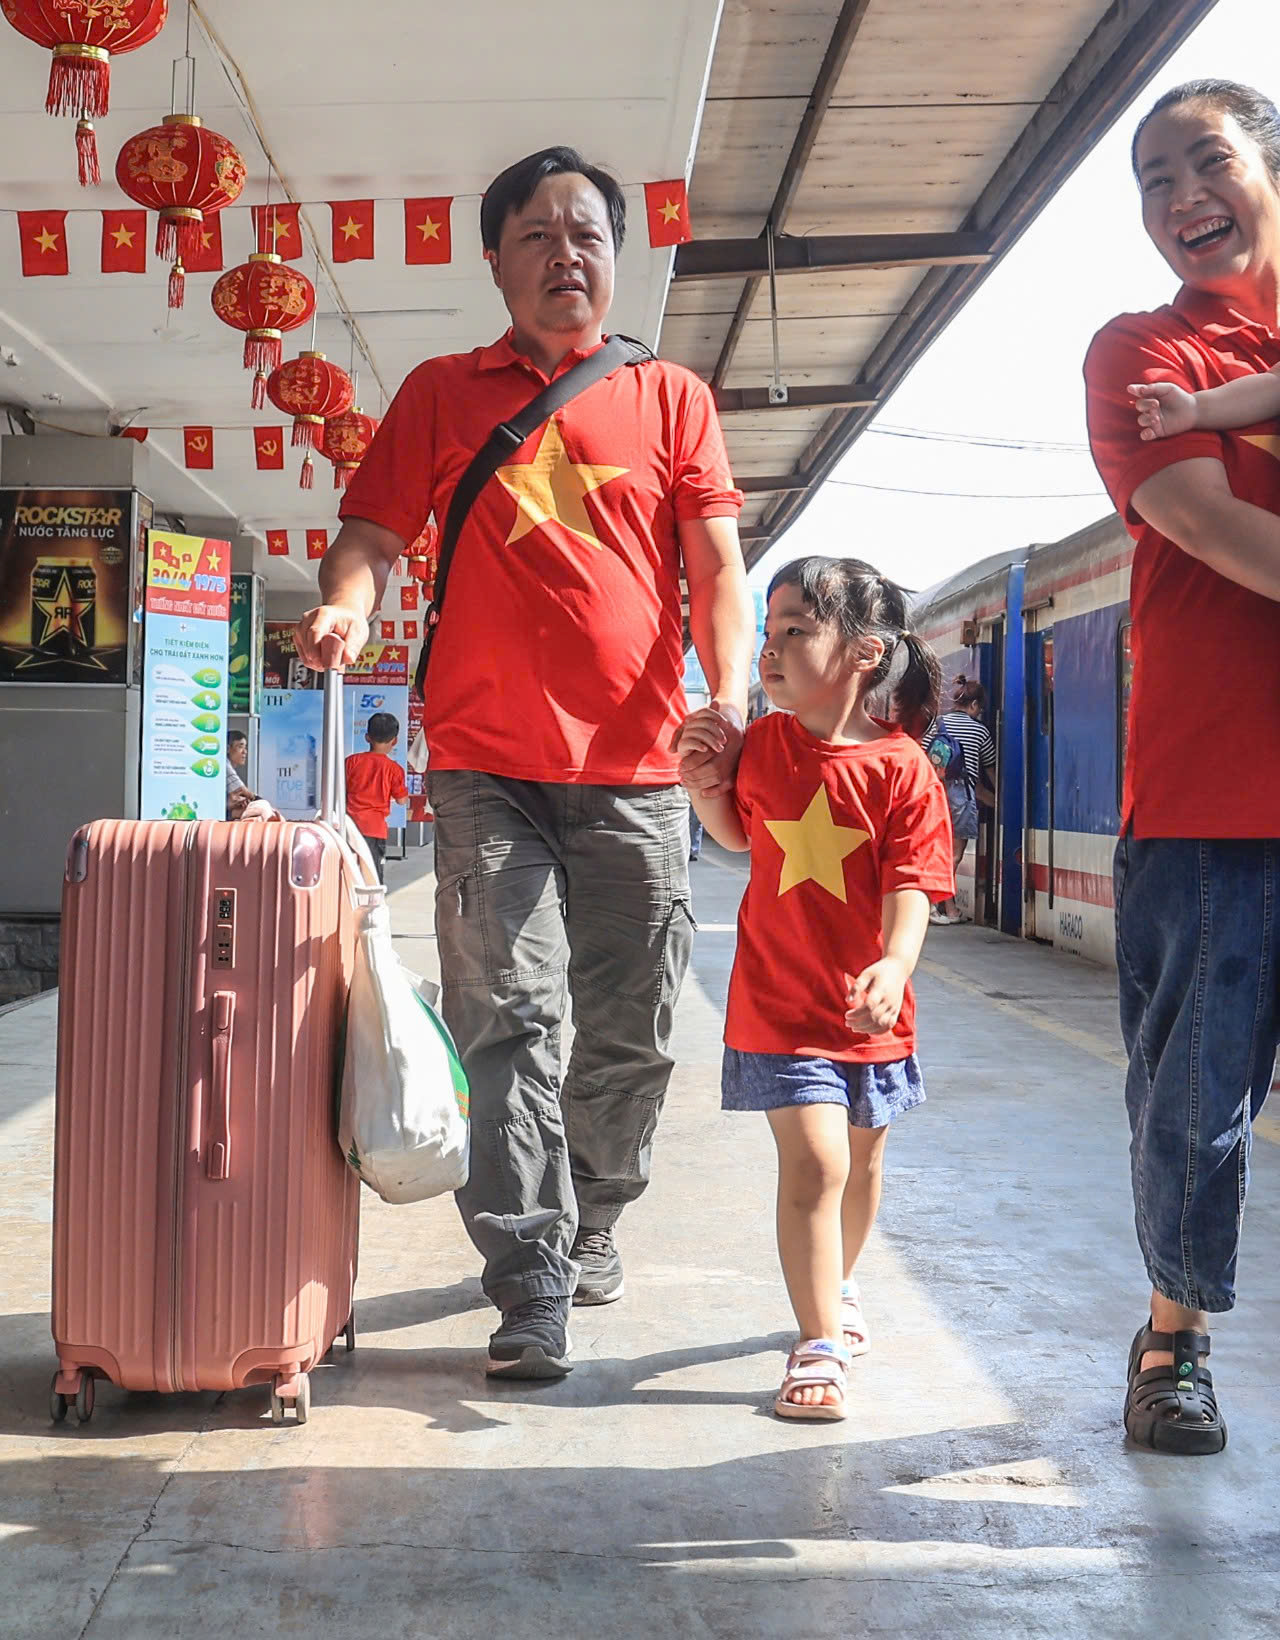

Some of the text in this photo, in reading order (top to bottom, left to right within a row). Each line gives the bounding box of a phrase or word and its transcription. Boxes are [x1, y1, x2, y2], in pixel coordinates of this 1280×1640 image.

[15, 506, 122, 526] ROCKSTAR
[19, 524, 115, 540] NƯỚC TĂNG LỰC
